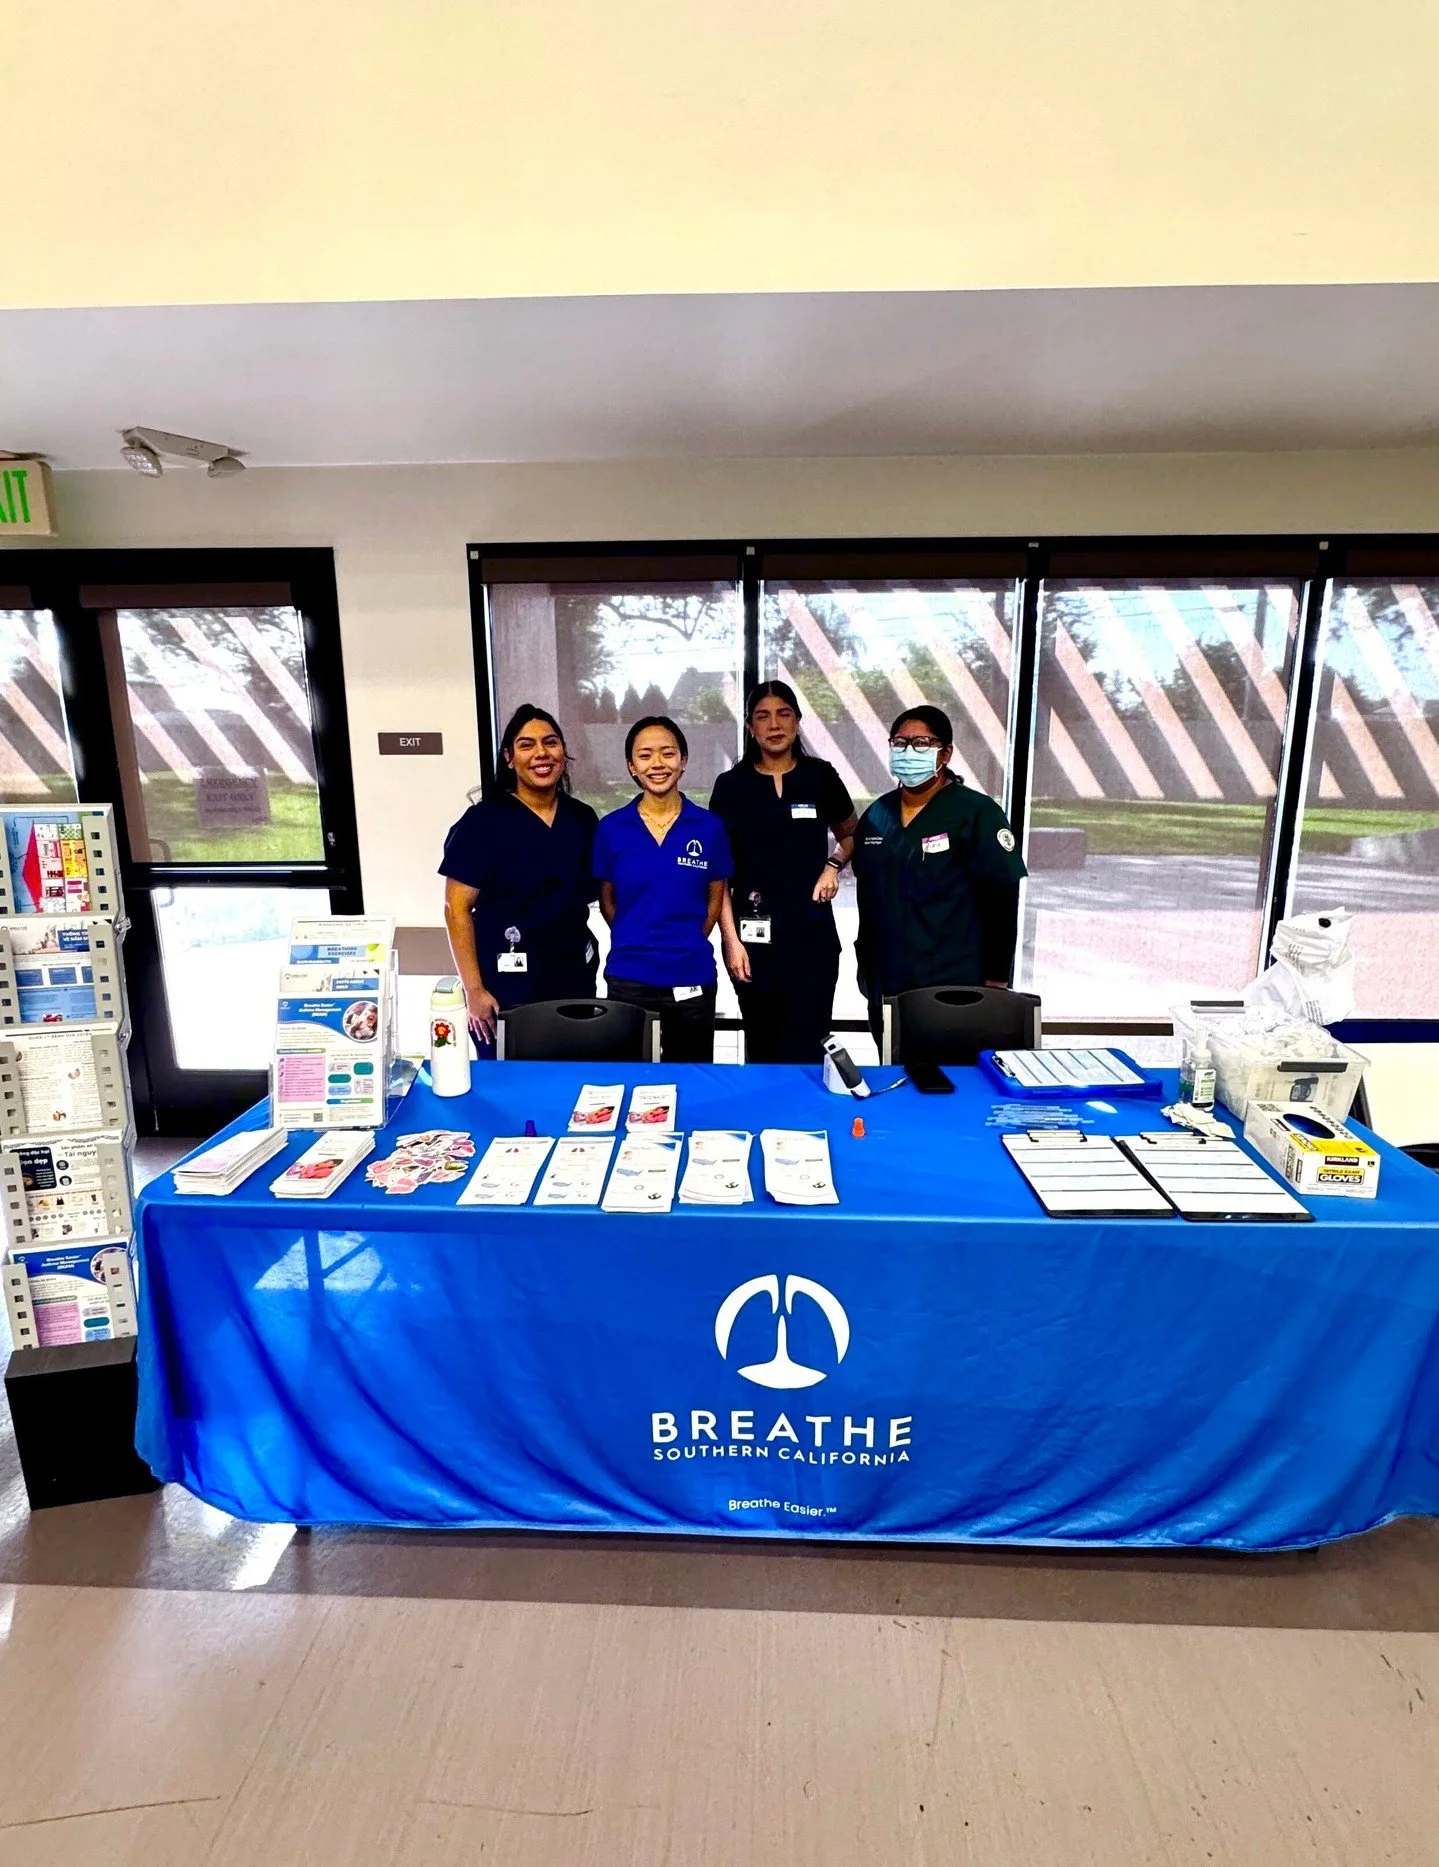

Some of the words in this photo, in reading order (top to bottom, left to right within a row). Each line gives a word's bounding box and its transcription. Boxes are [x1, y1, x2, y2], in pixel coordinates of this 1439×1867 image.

[399, 737, 422, 747] EXIT
[677, 857, 708, 866] BREATHE
[1319, 1174, 1361, 1183] GLOVES
[651, 1409, 913, 1448] BREATHE
[653, 1444, 769, 1461] SOUTHERN
[778, 1447, 910, 1467] CALIFORNIA
[728, 1498, 781, 1511] Breathe
